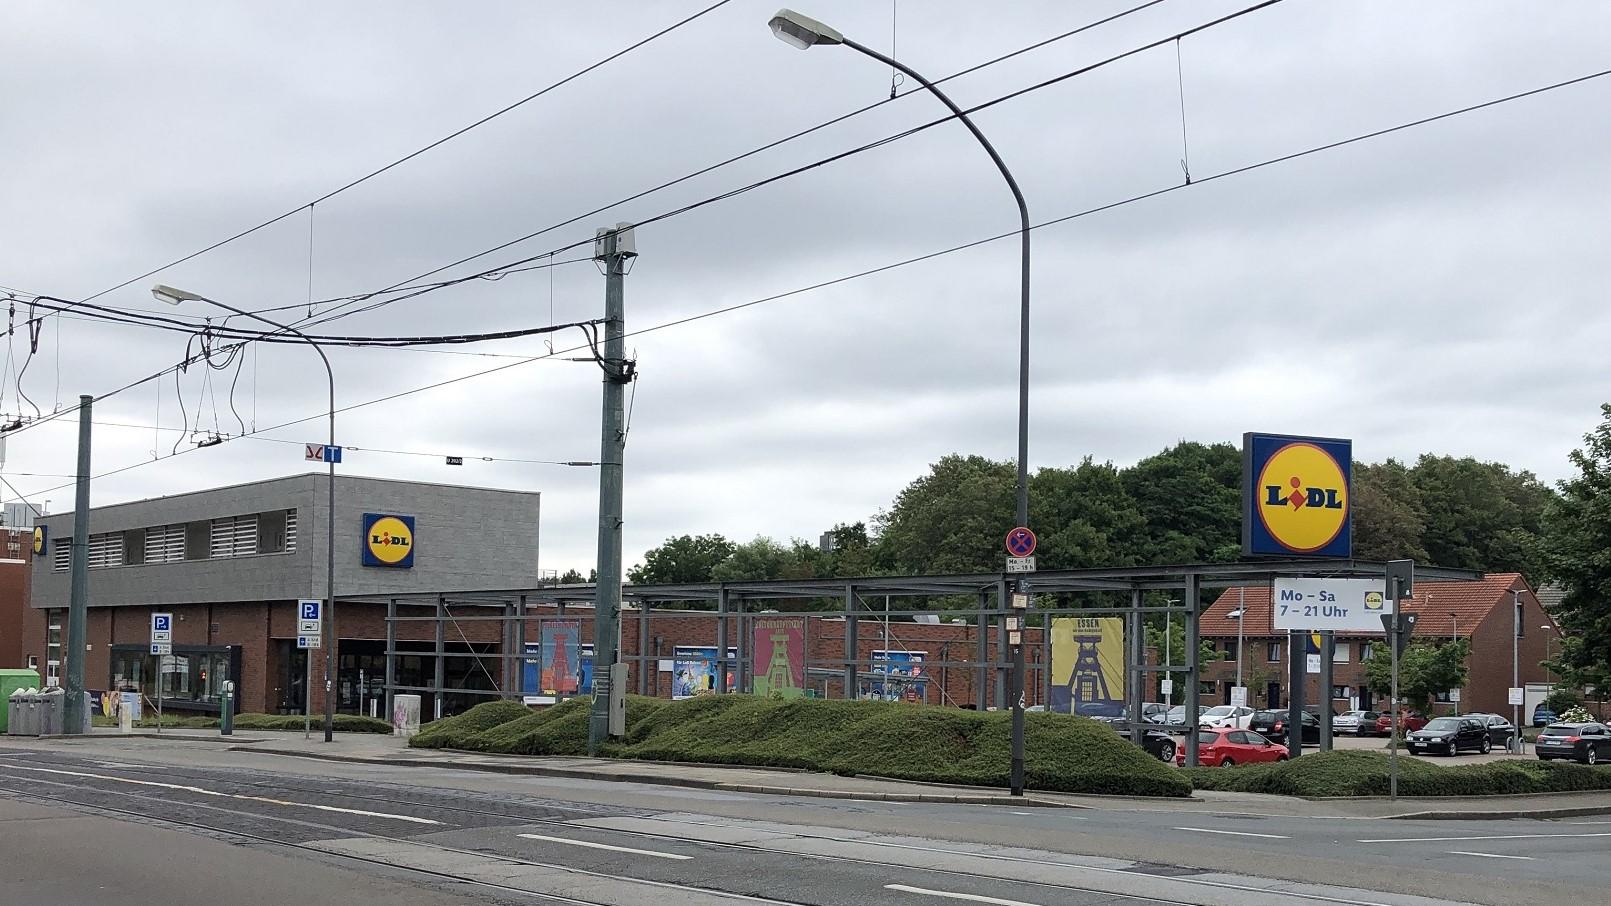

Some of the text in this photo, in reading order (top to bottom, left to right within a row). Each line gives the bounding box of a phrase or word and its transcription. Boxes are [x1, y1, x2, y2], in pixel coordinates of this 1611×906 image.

[1280, 589, 1303, 602] Mo
[1319, 590, 1336, 602] Sa
[303, 604, 314, 618] P
[1280, 605, 1289, 617] 7
[1303, 605, 1319, 617] 21
[1322, 605, 1349, 618] Uhr
[156, 617, 165, 629] P
